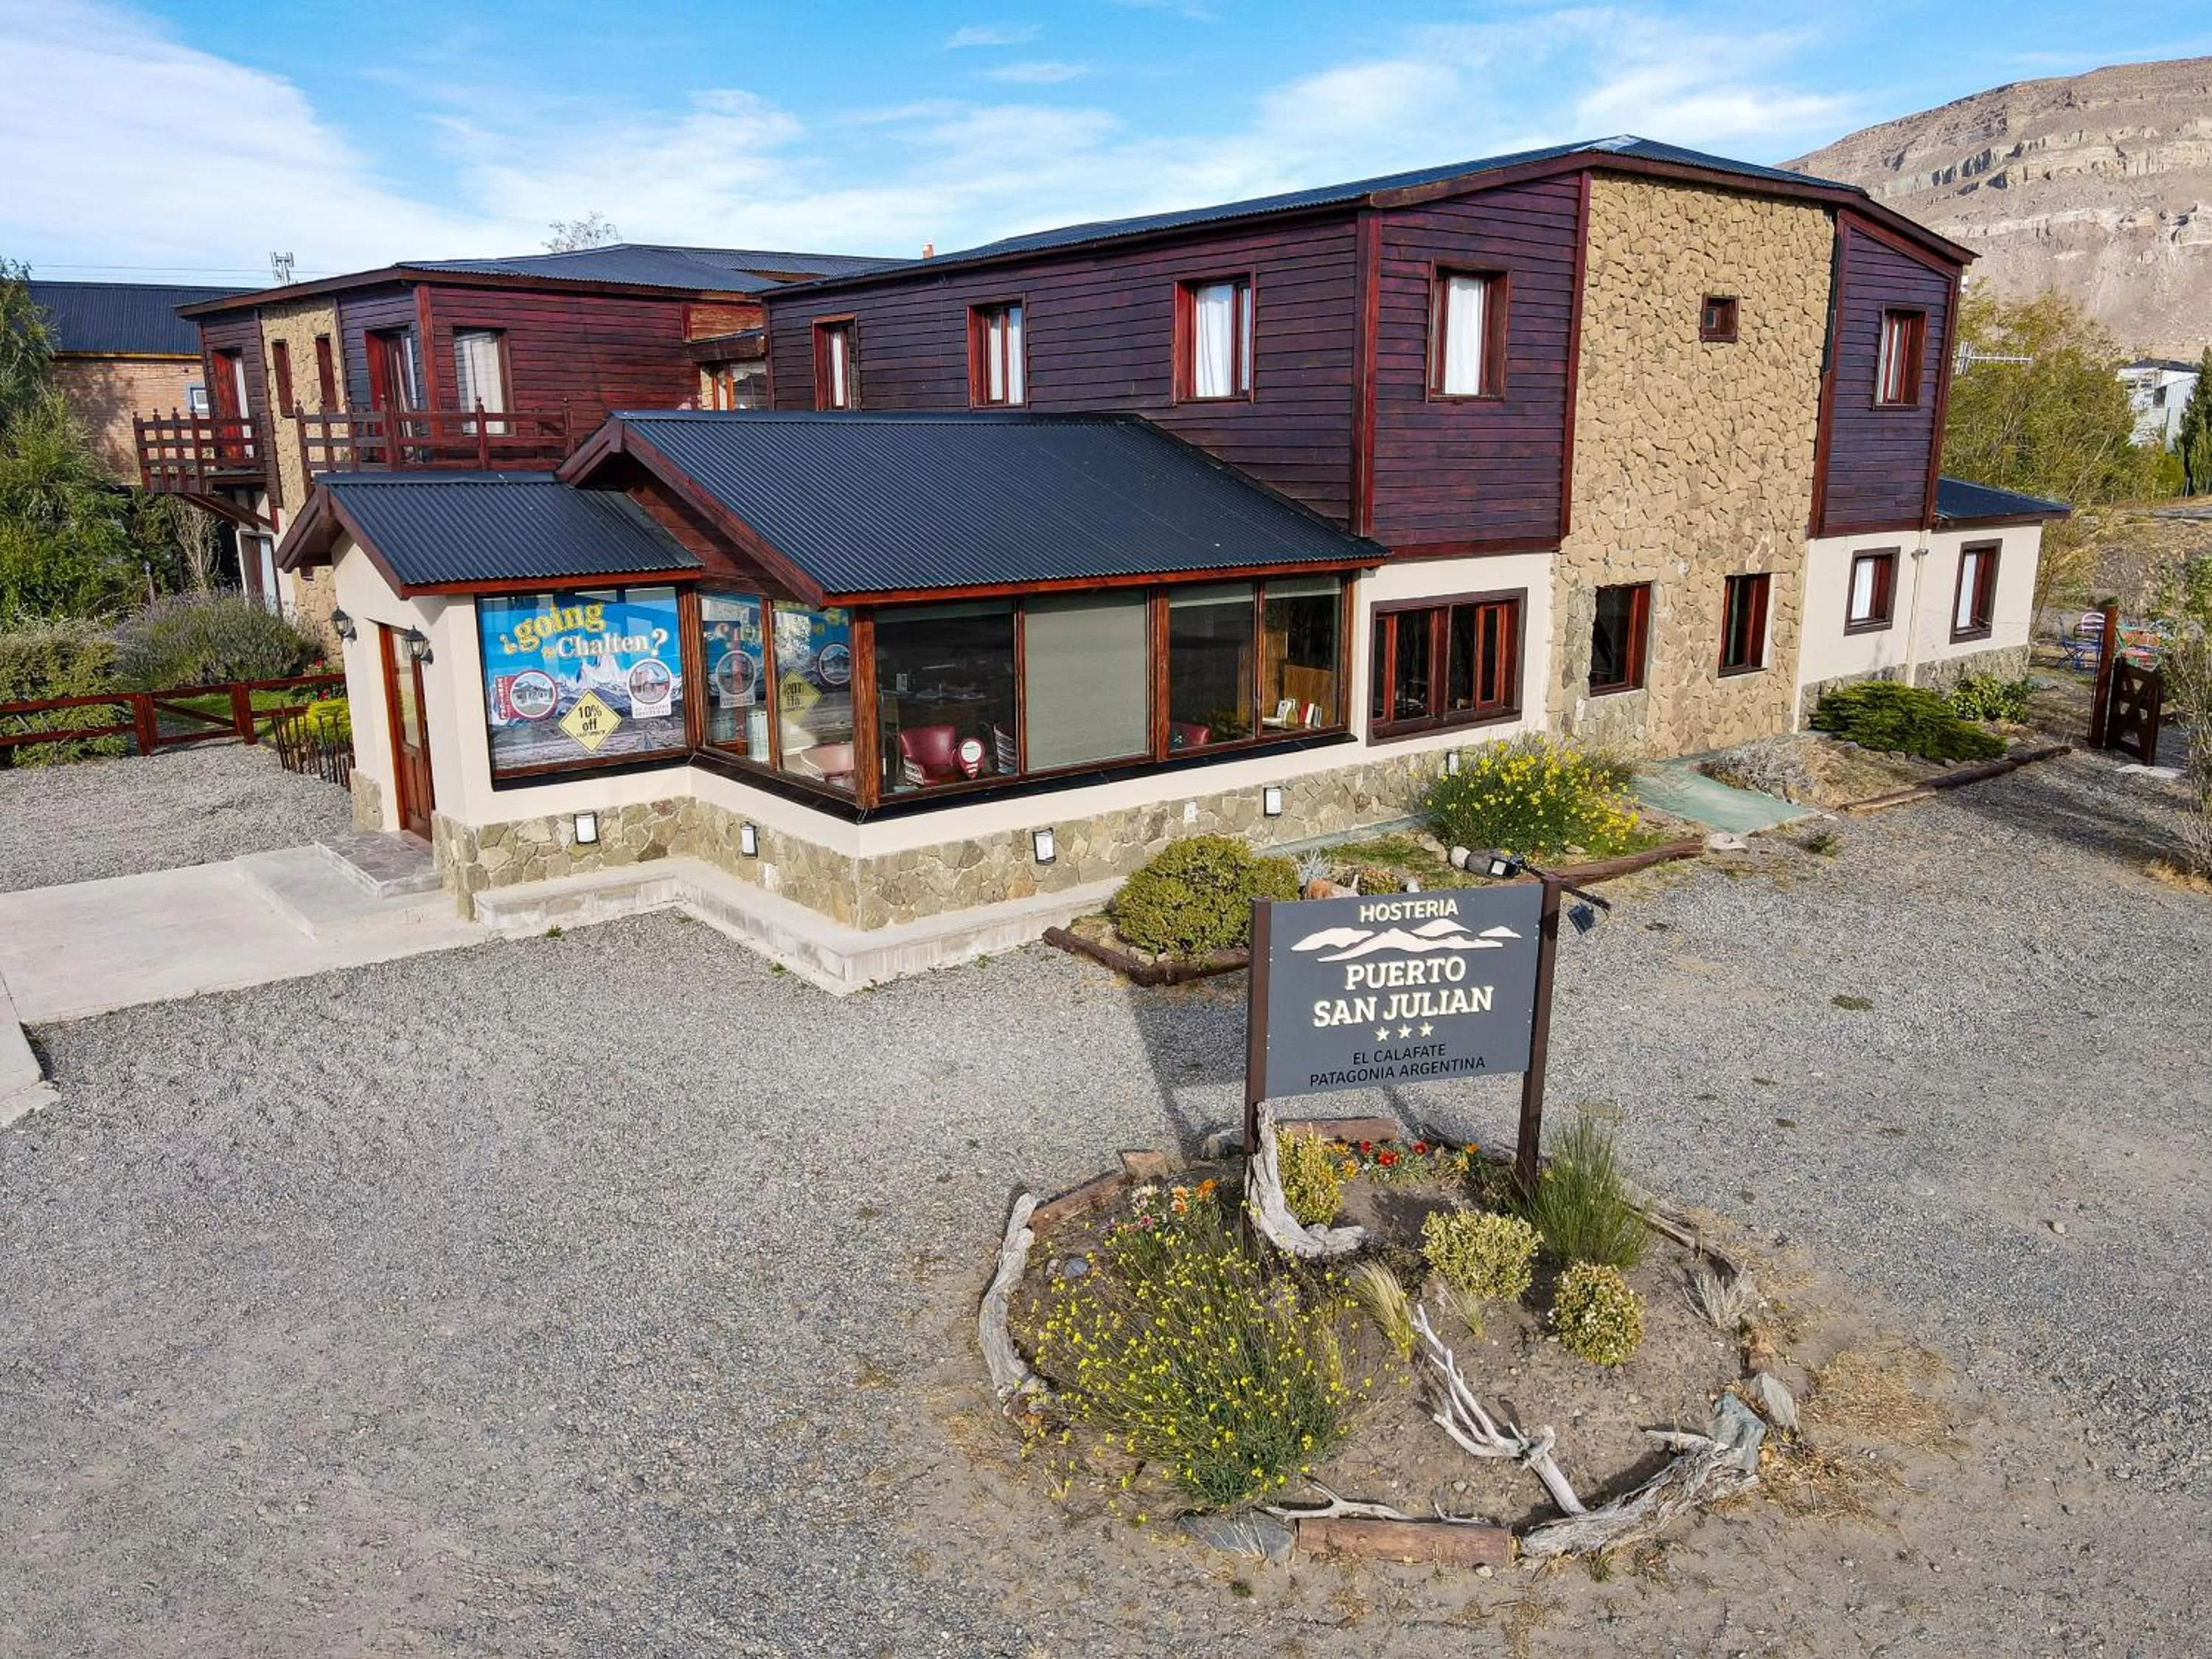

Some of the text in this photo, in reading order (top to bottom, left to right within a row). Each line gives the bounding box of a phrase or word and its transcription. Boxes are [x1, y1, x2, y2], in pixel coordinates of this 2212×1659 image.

[578, 705, 602, 718] 10%
[582, 718, 597, 731] off
[1359, 898, 1459, 923] HOSTERIA
[1344, 956, 1467, 991] PUERTO
[1312, 986, 1495, 1028] SAN JULIAN
[1352, 1043, 1447, 1065] EL CALAFATE
[1310, 1056, 1486, 1088] PATAGONIA ARGENTINA
